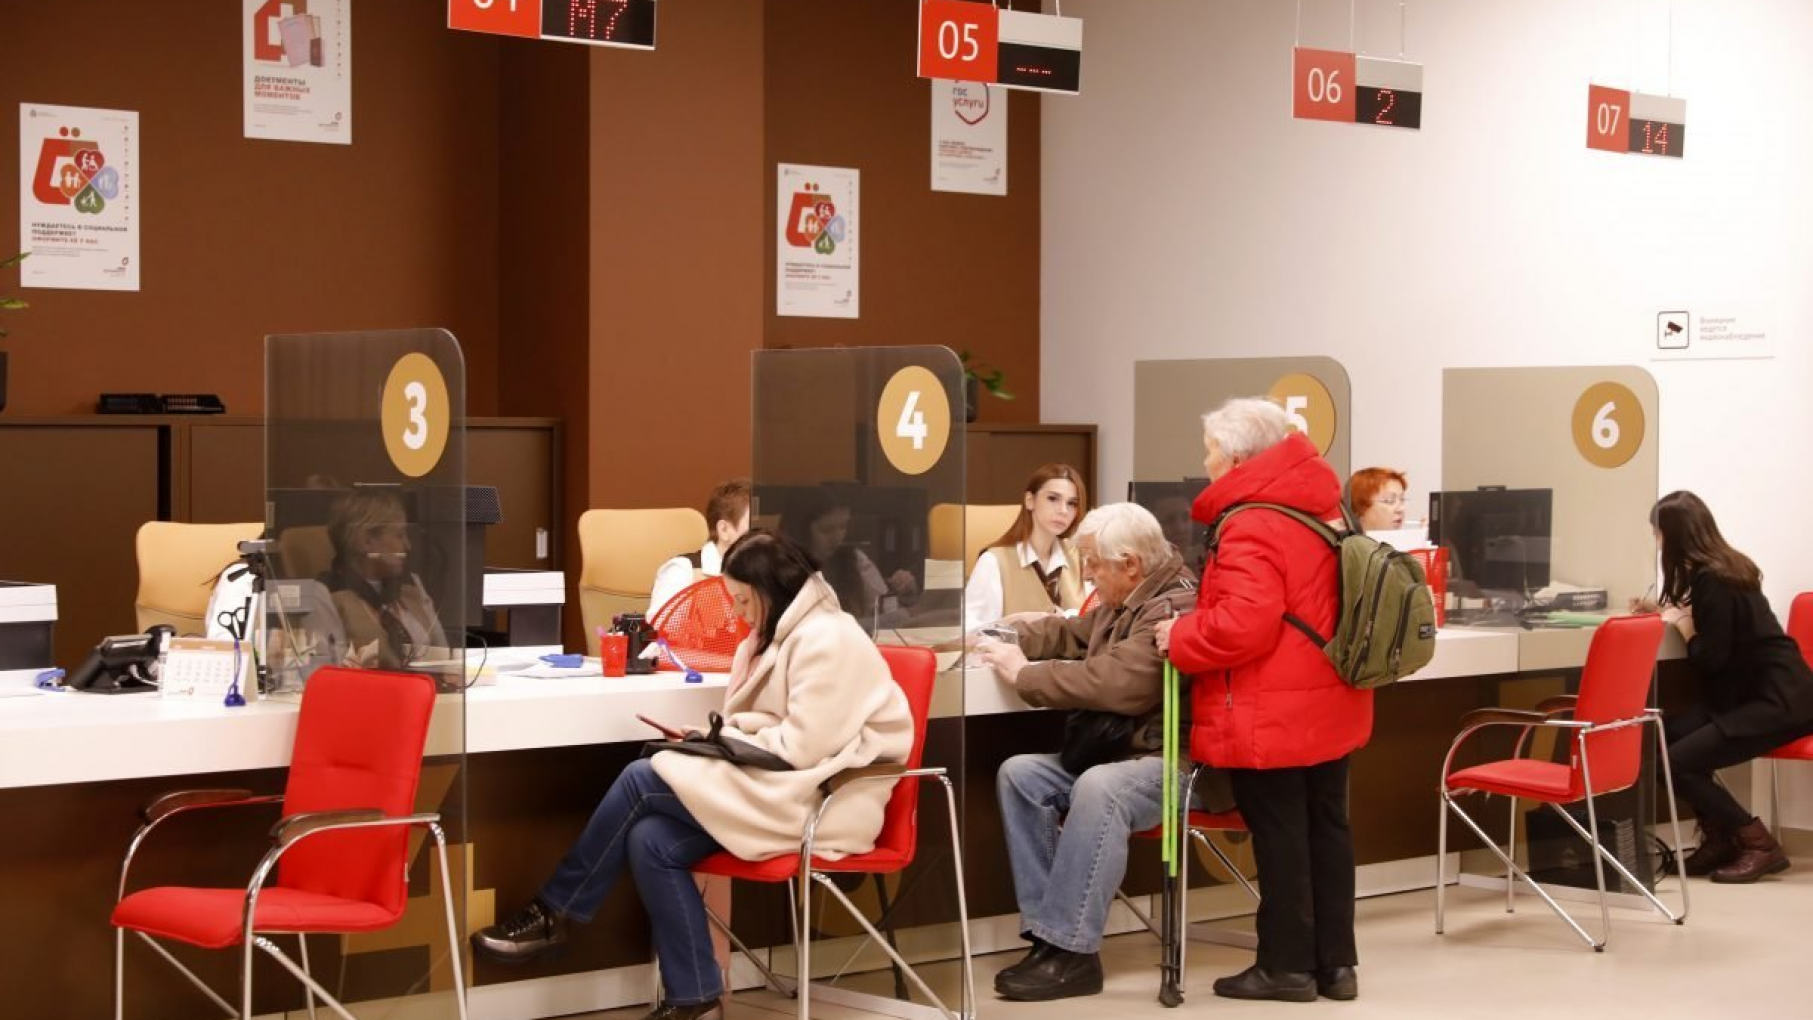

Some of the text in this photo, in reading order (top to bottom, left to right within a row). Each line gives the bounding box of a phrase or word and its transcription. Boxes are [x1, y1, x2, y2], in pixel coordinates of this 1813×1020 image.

[938, 20, 979, 62] 05
[1307, 67, 1341, 104] 06
[1375, 89, 1393, 124] 2
[1597, 102, 1621, 136] 07
[1641, 121, 1669, 154] 14
[403, 381, 427, 450] 3
[896, 391, 927, 450] 4
[1284, 395, 1308, 437] 5
[1592, 401, 1620, 448] 6
